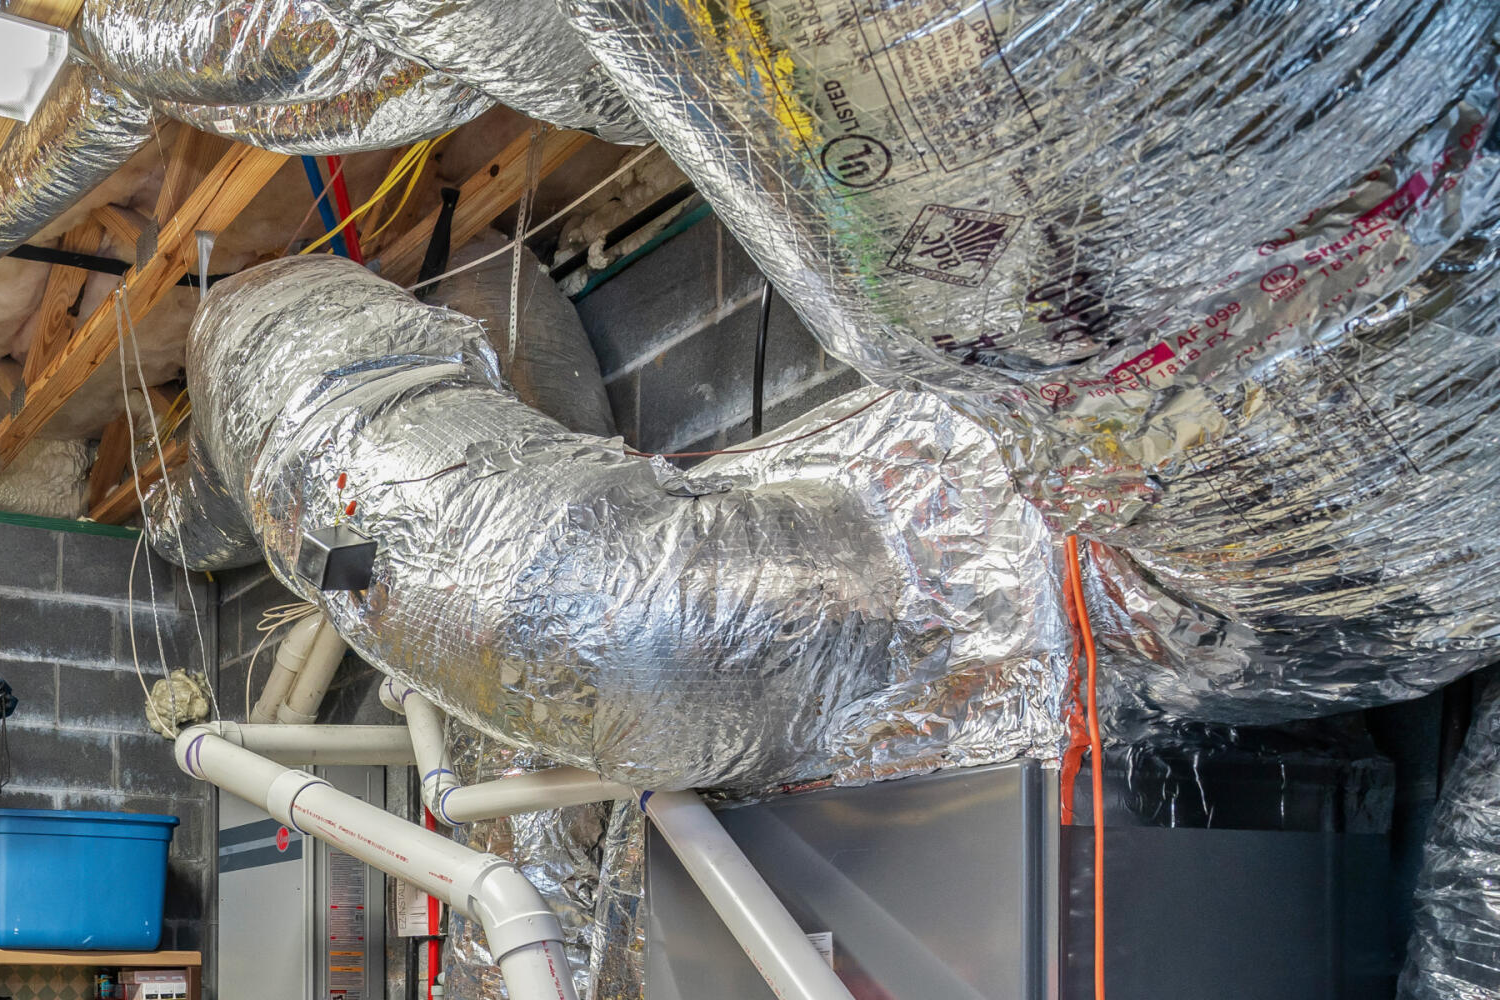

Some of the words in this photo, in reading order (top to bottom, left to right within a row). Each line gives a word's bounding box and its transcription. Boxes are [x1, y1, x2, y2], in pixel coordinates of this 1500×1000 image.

[823, 79, 860, 134] LISTED
[917, 231, 961, 272] adc
[1176, 325, 1202, 350] AF
[1204, 301, 1243, 329] 099
